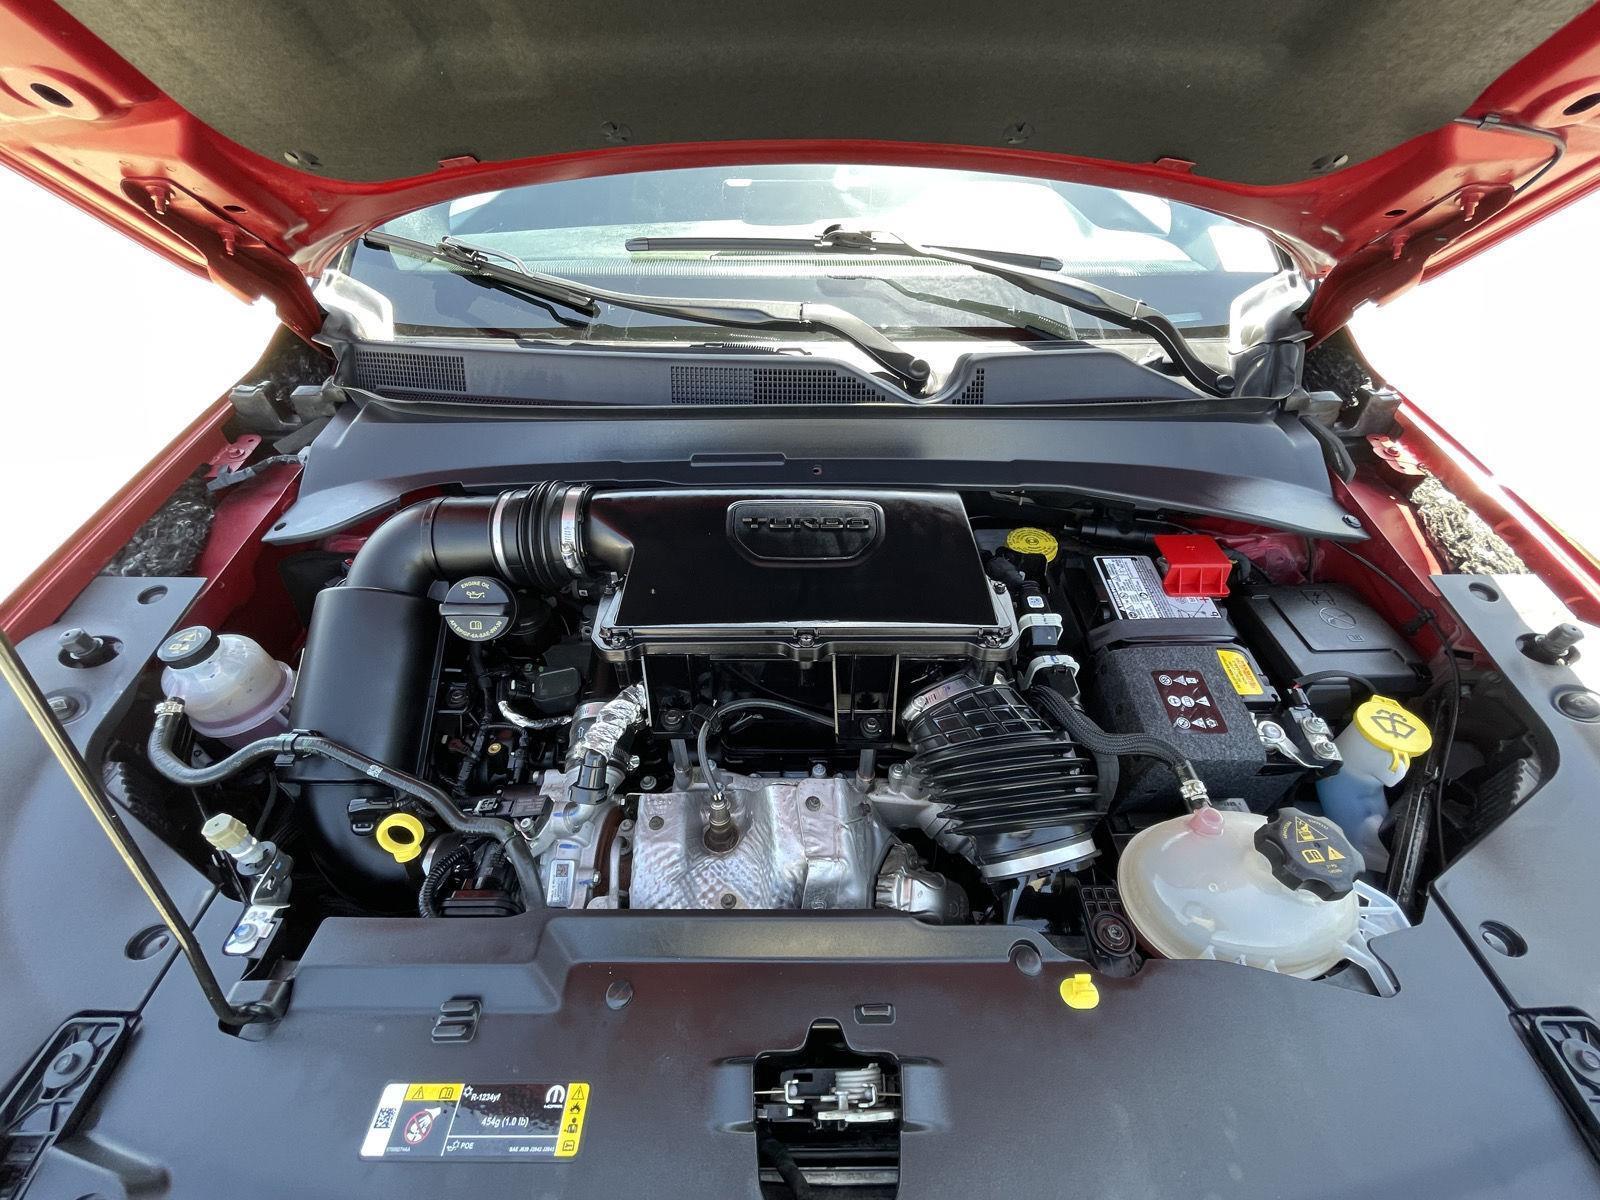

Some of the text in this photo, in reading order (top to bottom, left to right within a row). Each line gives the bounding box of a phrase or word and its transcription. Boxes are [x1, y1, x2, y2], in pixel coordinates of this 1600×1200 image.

[742, 517, 870, 530] TURBO
[460, 580, 490, 590] ENGINE OIL
[470, 1093, 502, 1103] R-1234yf
[480, 1116, 529, 1128] 454g (1.0 lb)
[460, 1142, 474, 1150] POE
